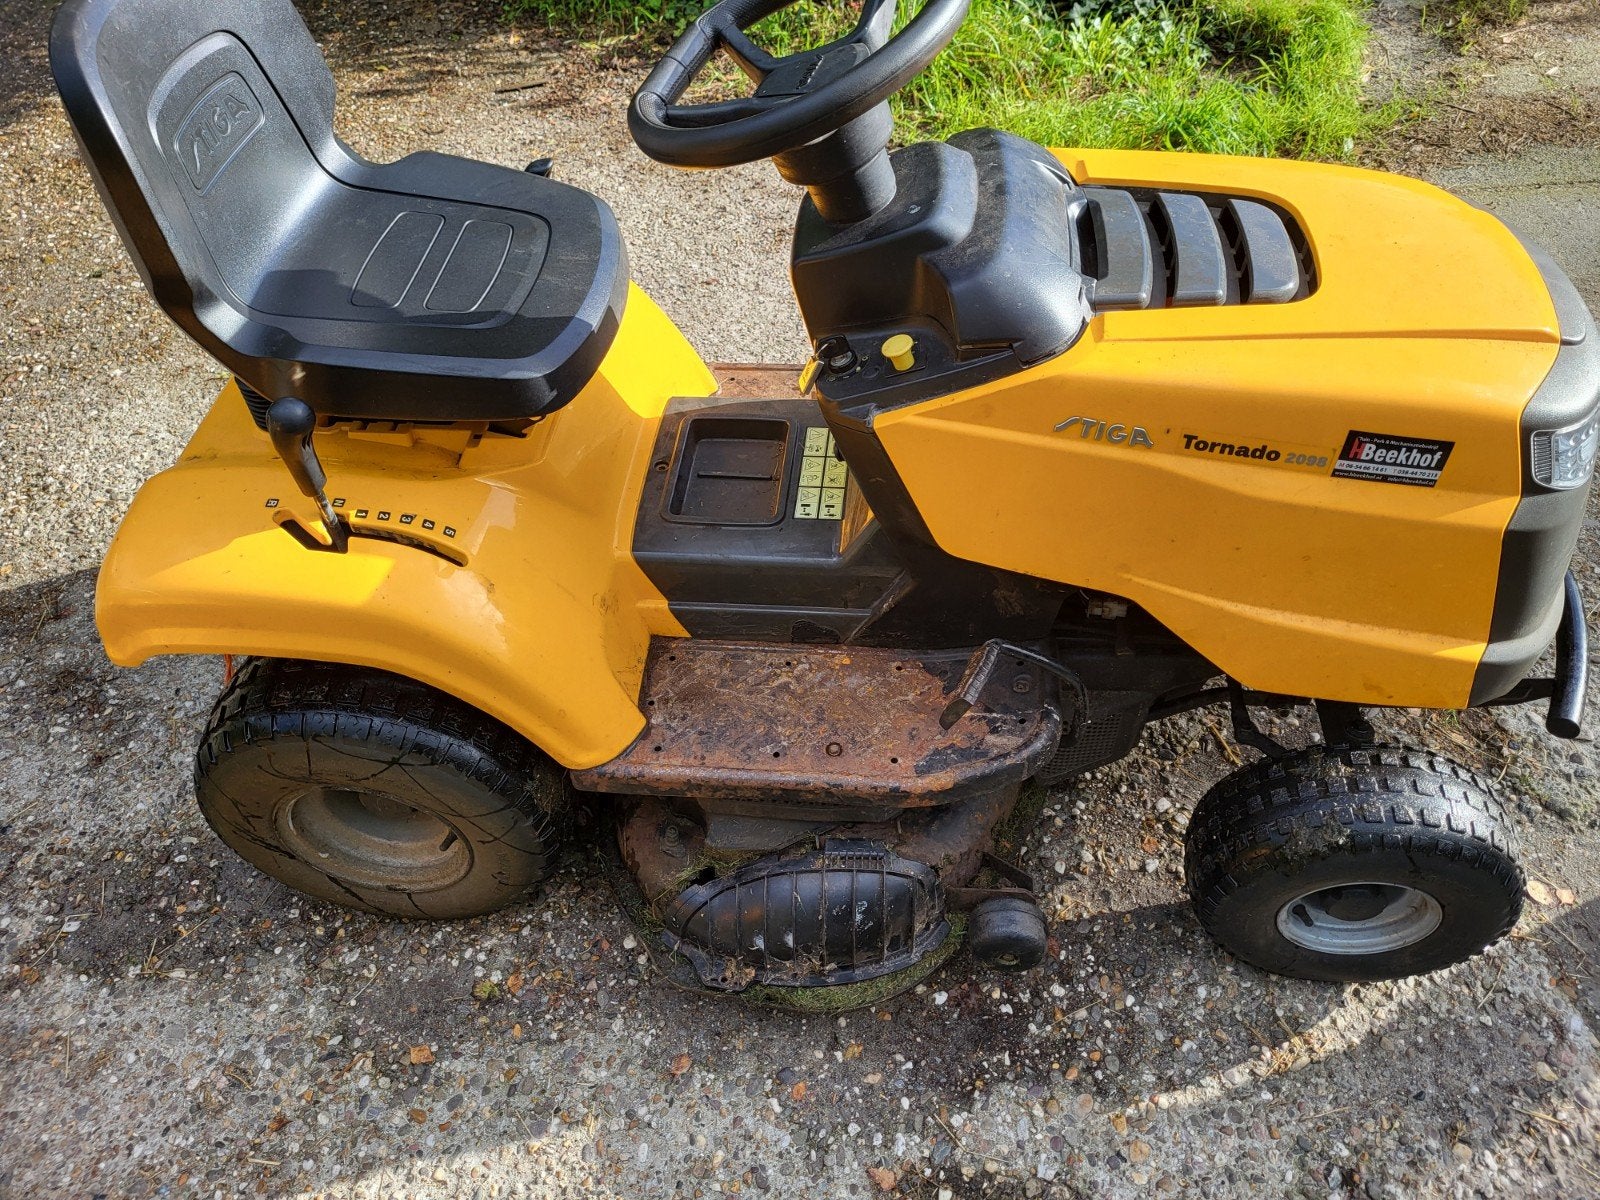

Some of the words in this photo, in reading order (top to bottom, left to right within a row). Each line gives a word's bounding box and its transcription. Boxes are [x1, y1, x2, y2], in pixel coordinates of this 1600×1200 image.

[190, 93, 252, 175] STIGA
[1053, 415, 1155, 448] STIGA
[1183, 433, 1281, 463] Tornado
[1284, 452, 1329, 468] 2098
